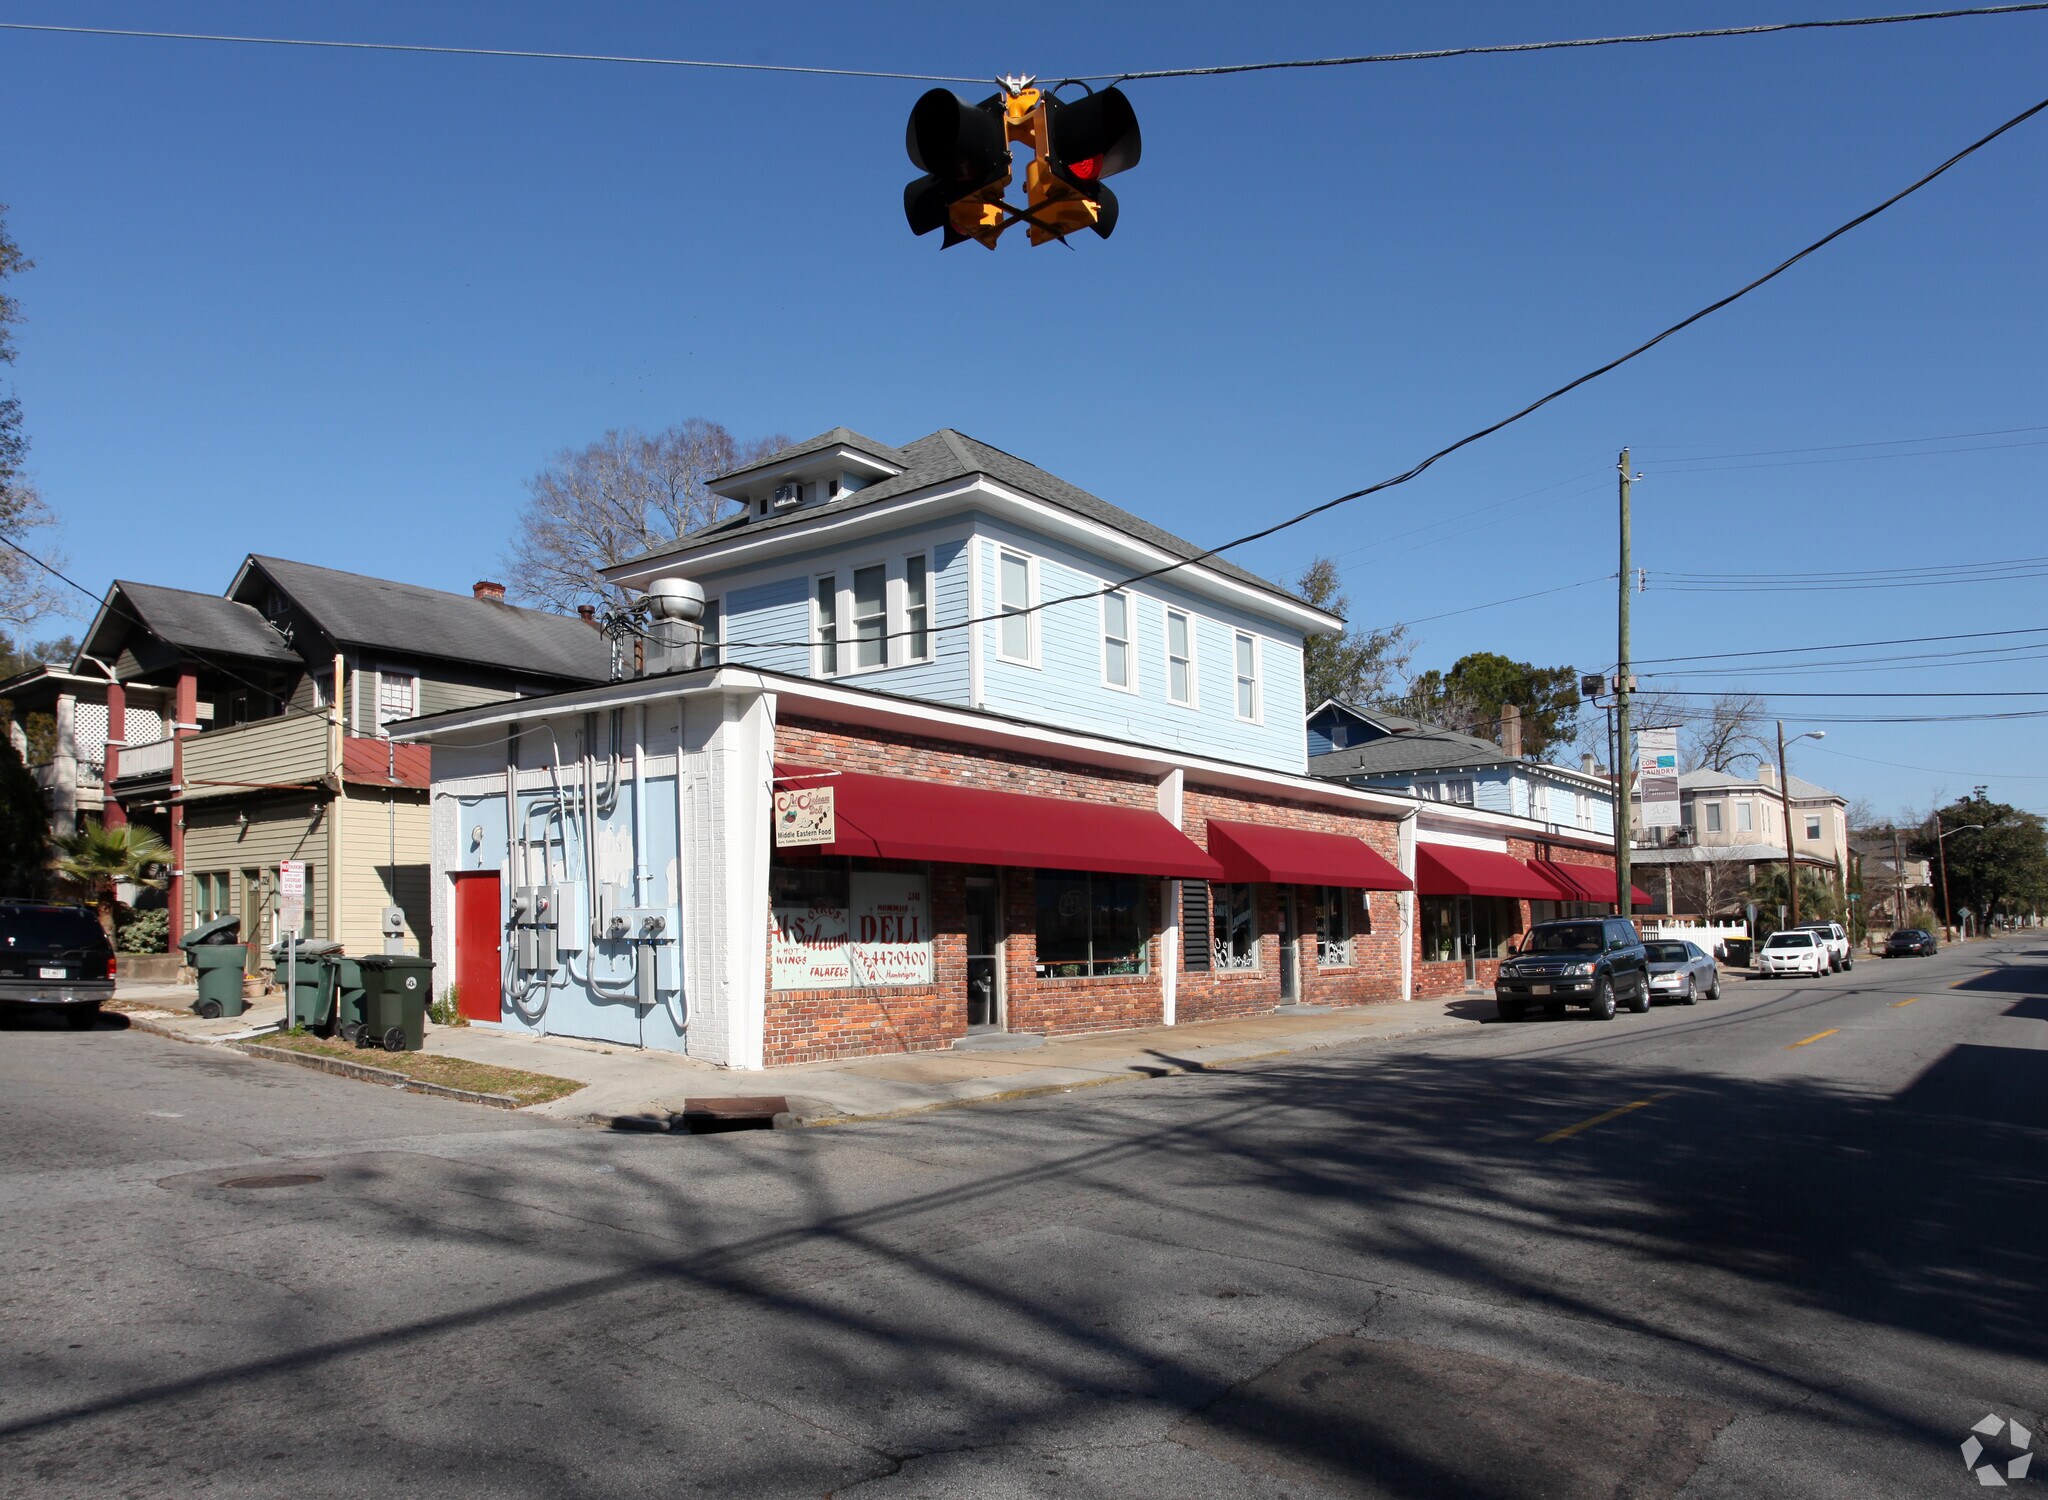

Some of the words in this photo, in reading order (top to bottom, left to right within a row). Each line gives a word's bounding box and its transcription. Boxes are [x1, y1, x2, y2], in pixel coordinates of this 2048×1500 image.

[1642, 768, 1675, 776] LAUNDRY
[778, 831, 796, 839] Middle
[797, 829, 818, 838] Eastern
[818, 827, 832, 836] Food
[877, 904, 909, 913] HUMMUS
[860, 915, 920, 945] DELI
[776, 956, 807, 965] WINGS
[809, 967, 849, 977] FALAFELS
